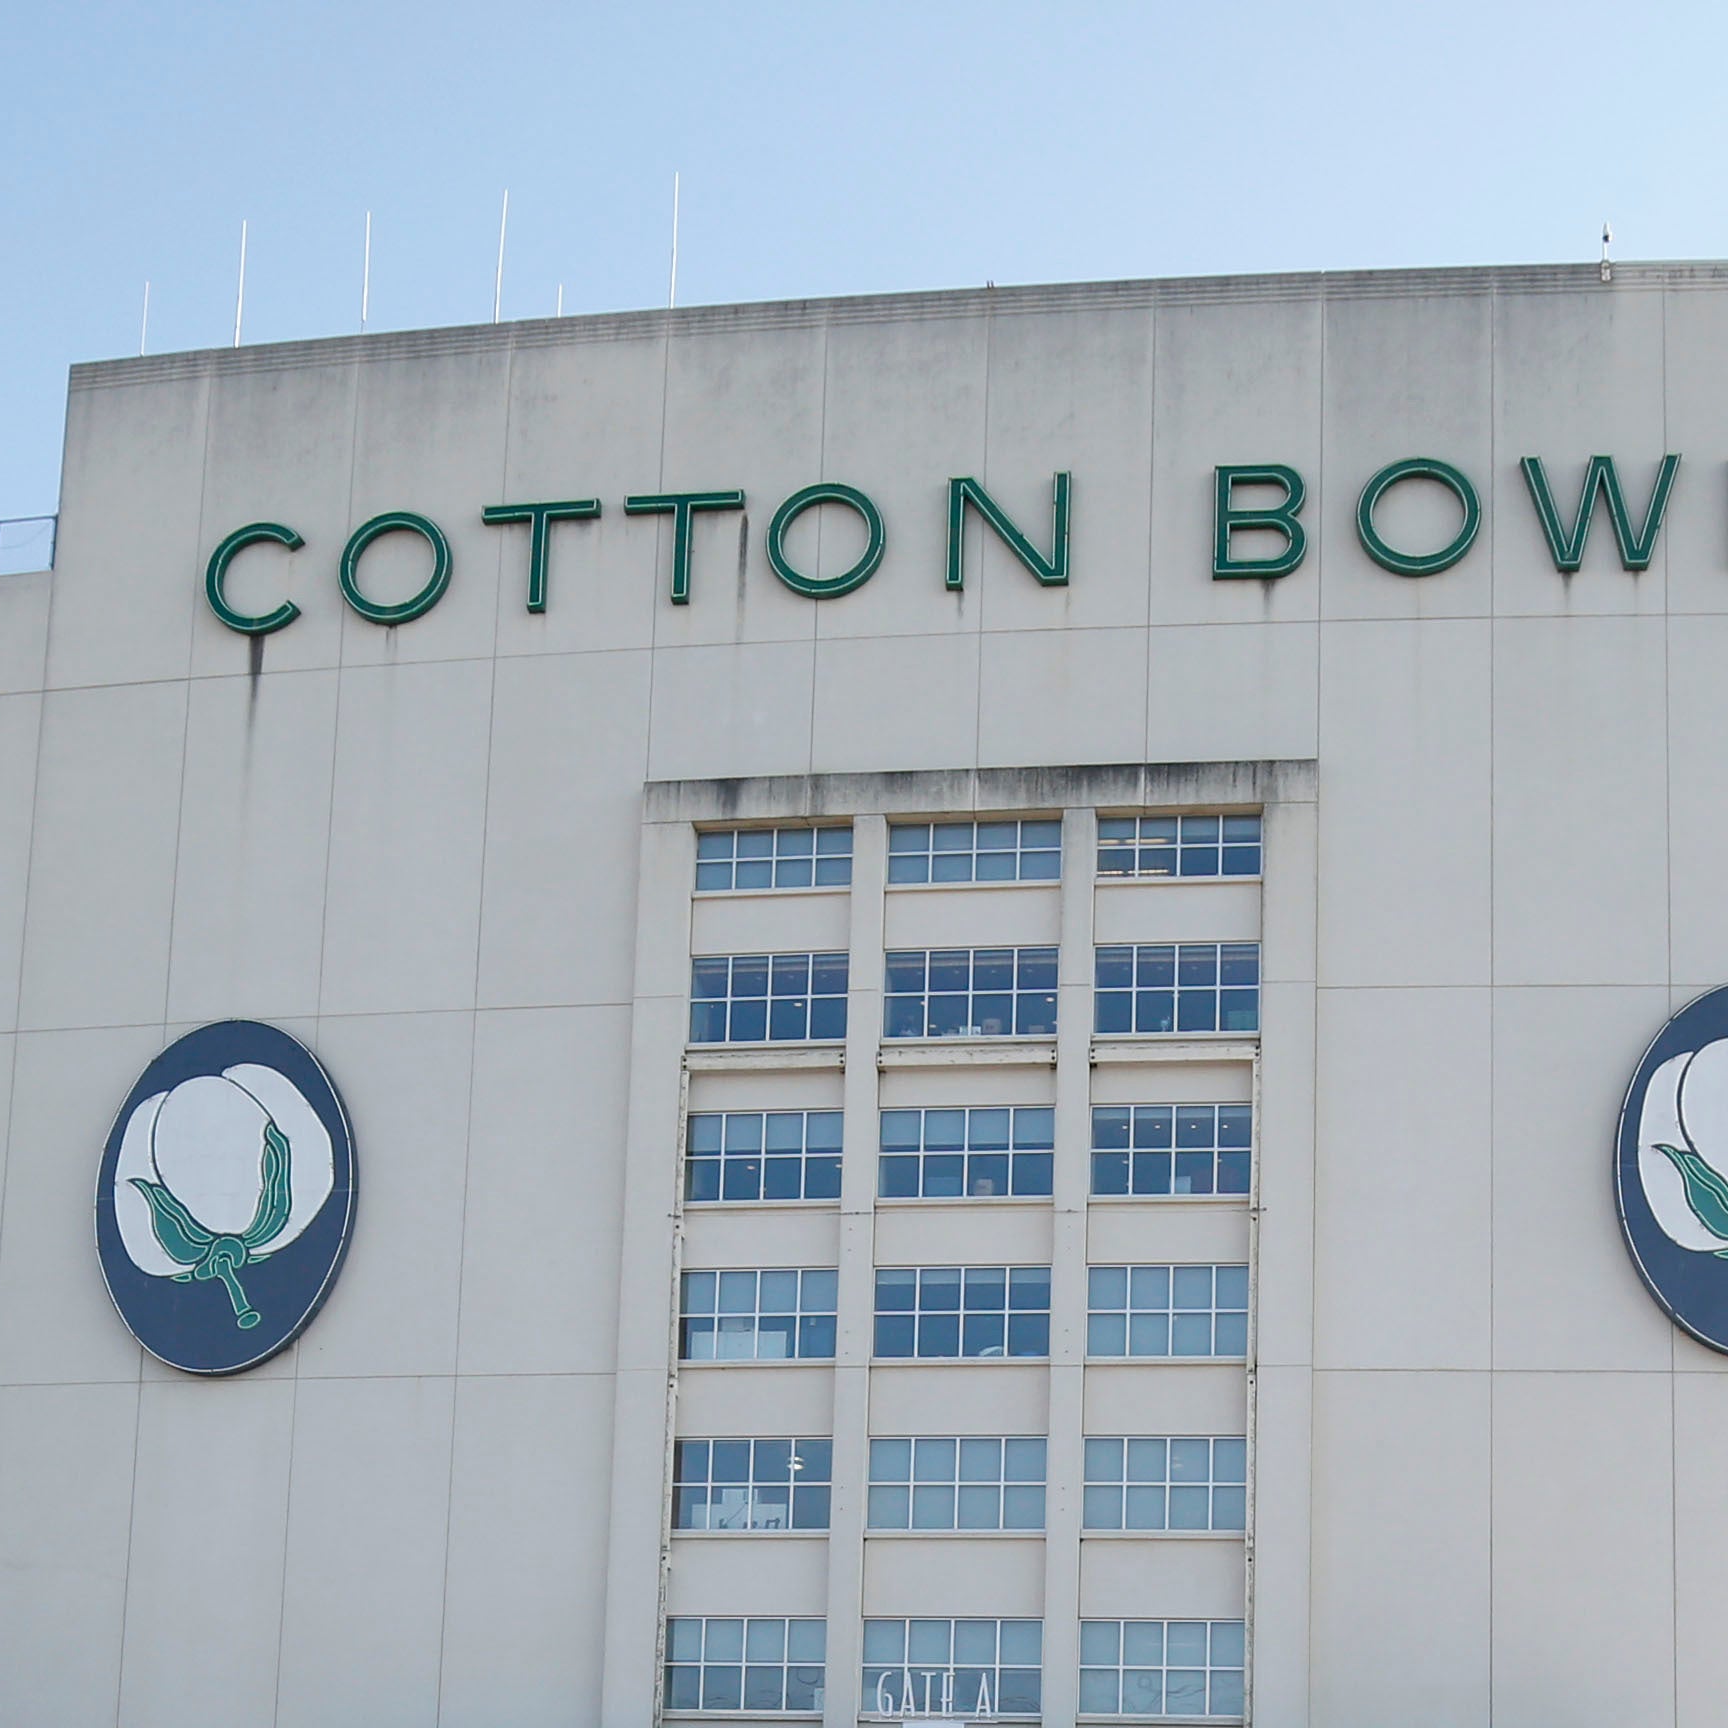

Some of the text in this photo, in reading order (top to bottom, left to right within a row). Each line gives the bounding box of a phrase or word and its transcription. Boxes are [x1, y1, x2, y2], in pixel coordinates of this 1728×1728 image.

[204, 468, 1075, 635] COTTON
[877, 1671, 991, 1717] GATE A
